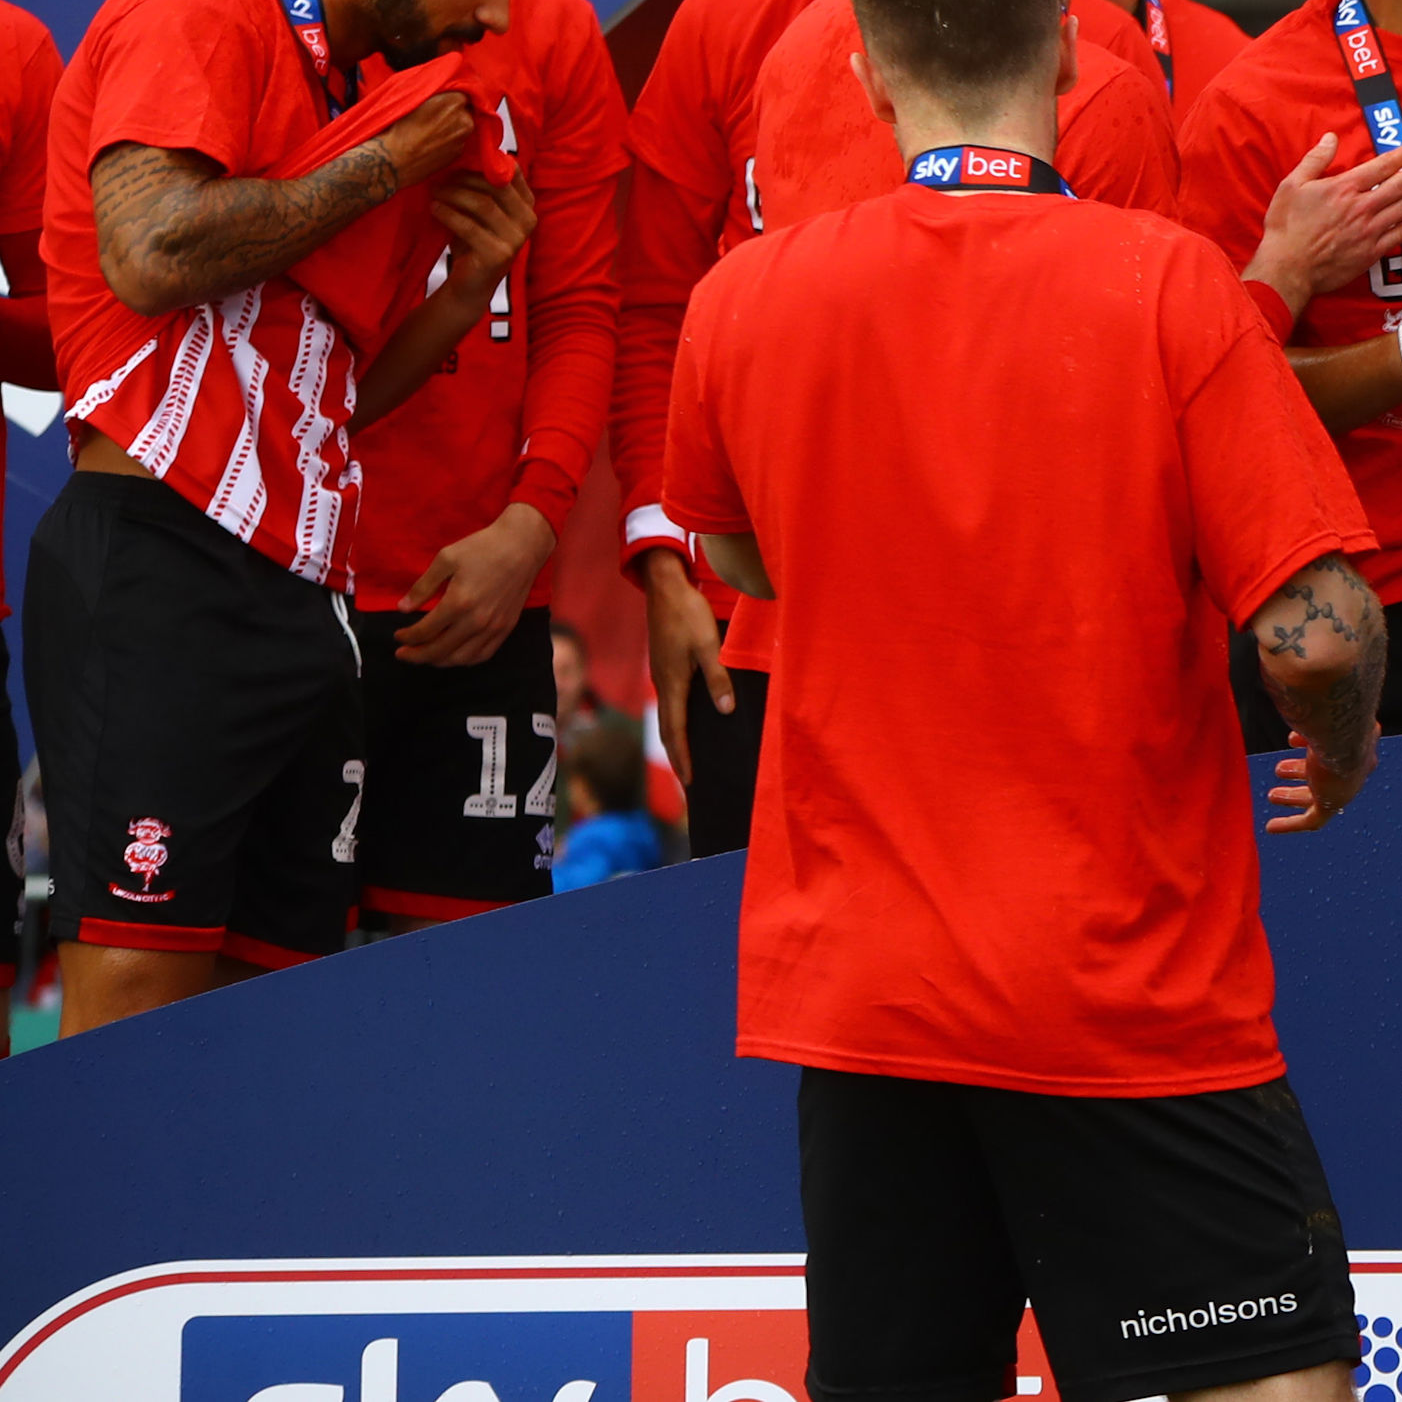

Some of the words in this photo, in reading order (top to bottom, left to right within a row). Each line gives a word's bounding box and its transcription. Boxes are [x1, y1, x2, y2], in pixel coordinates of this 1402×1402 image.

[302, 28, 327, 70] bet
[1347, 29, 1378, 73] bet
[1374, 107, 1402, 146] sky
[914, 154, 960, 182] sky
[967, 151, 1022, 179] bet
[1120, 1293, 1298, 1339] nicholsons
